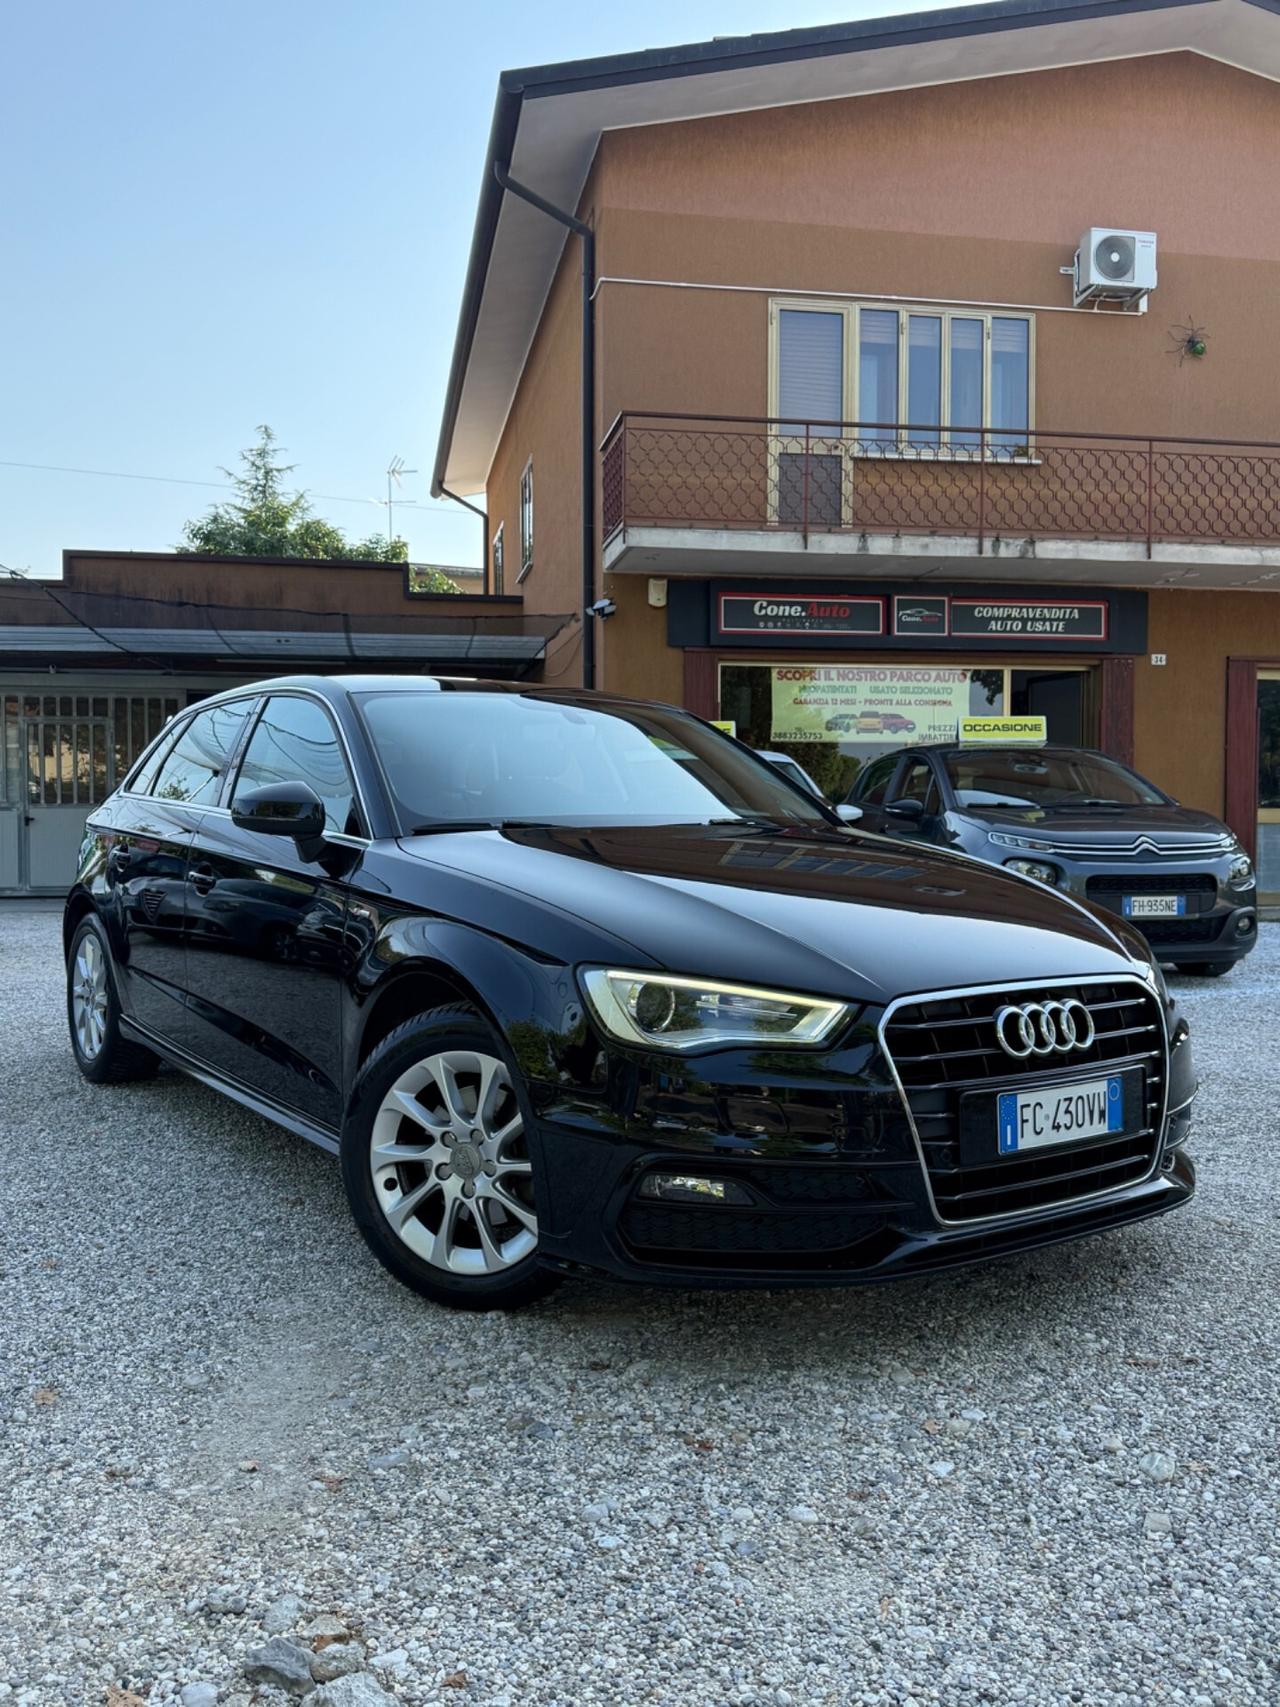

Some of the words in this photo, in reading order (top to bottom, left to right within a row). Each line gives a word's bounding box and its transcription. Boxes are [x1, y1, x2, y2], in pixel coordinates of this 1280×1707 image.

[974, 606, 1080, 620] COMPRAVENDITA
[987, 620, 1022, 632] AUTO
[1026, 621, 1066, 633] USATE
[776, 669, 821, 681] SCOPRI
[822, 670, 834, 681] IL
[837, 670, 888, 682] NOSTRO
[889, 671, 932, 682] PARCO
[933, 671, 968, 683] AUTO
[869, 685, 898, 694] USATO
[863, 698, 894, 706] PRONTE
[895, 698, 912, 706] ALLA
[963, 723, 1042, 732] OCCASIONE
